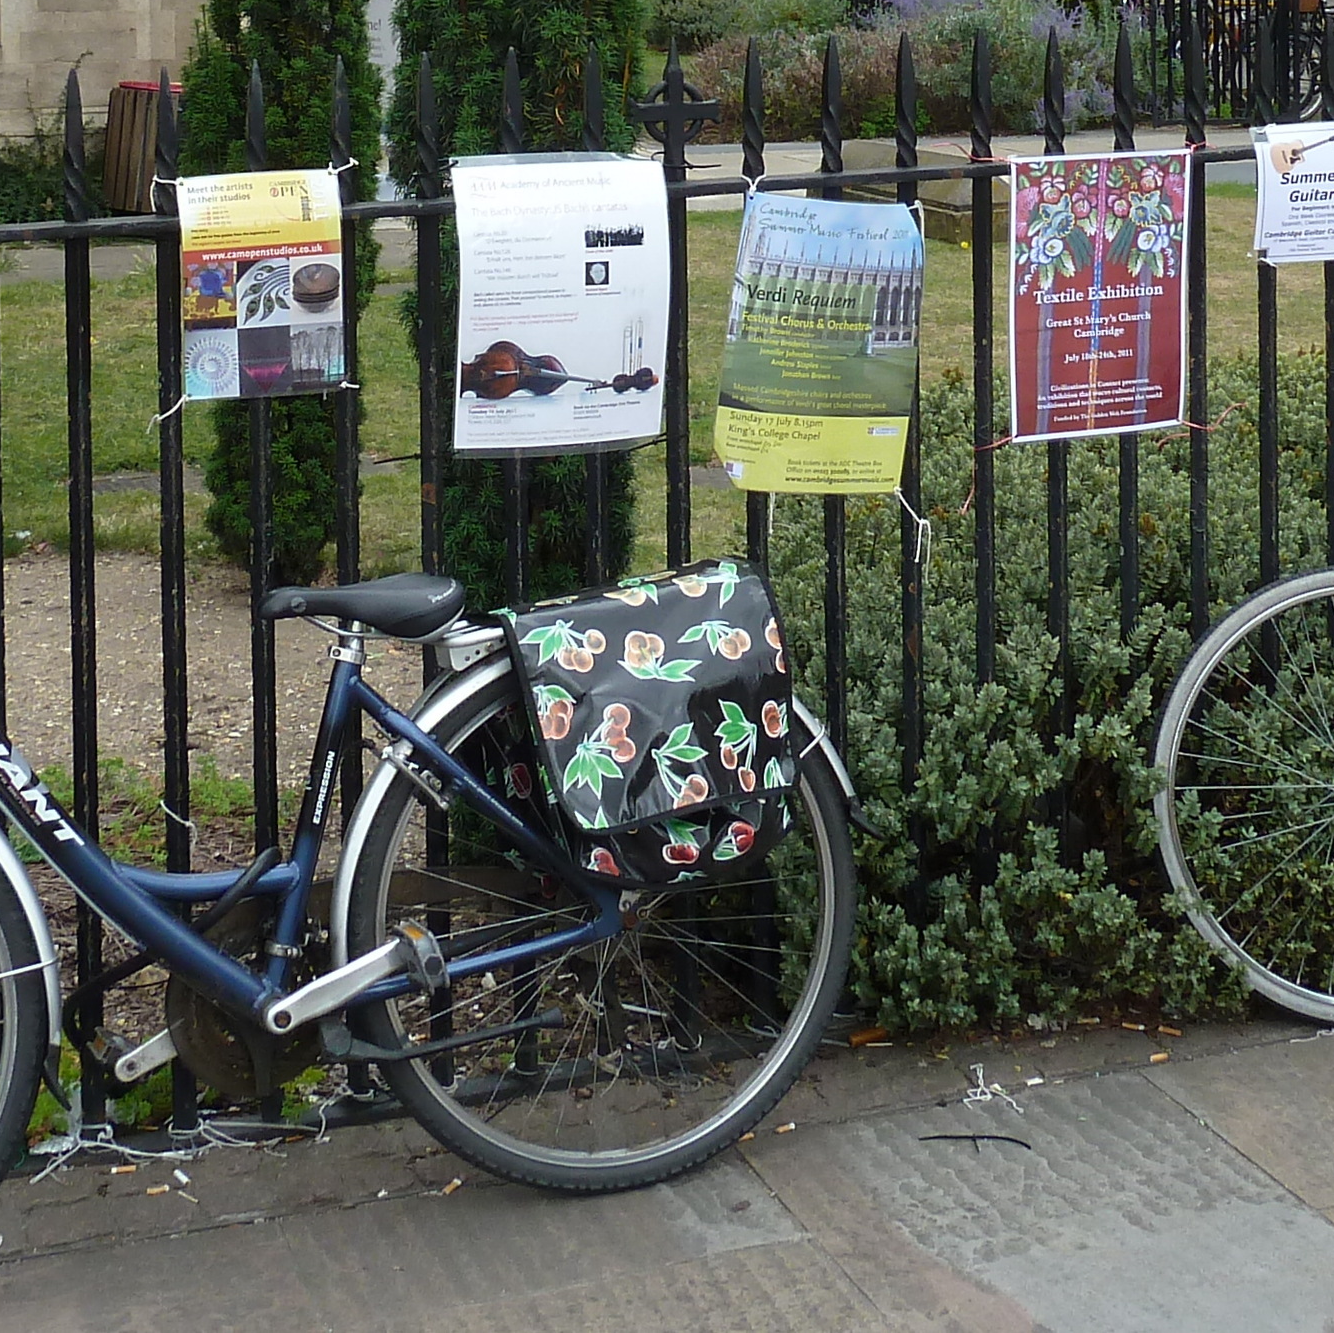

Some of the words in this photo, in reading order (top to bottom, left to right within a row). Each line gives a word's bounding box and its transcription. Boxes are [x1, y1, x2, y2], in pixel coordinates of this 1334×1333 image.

[187, 185, 209, 195] Meet
[211, 183, 225, 193] the
[225, 181, 253, 192] artists
[500, 179, 539, 190] Academy
[198, 194, 218, 204] their
[219, 192, 251, 203] studios
[760, 202, 817, 224] Cambridge
[759, 218, 806, 234] Summer
[847, 227, 889, 241] Festival
[202, 242, 323, 262] www.camopenstudios.co.uk
[747, 284, 787, 304] Verdi
[792, 289, 857, 312] Requiem
[1033, 287, 1084, 305] Textile
[1087, 282, 1163, 300] Exhibition
[742, 312, 777, 326] Festival
[781, 316, 814, 330] Chorus
[816, 319, 824, 329] &
[827, 320, 872, 331] Orchestra
[1046, 317, 1072, 328] Great
[1073, 316, 1083, 326] St
[1085, 313, 1117, 326] Mary's
[1118, 311, 1151, 322] Church
[1073, 326, 1125, 339] Cambridge
[1064, 354, 1080, 364] July
[1117, 349, 1134, 358] 2011
[729, 411, 762, 426] Sunday
[776, 416, 791, 428] July
[728, 423, 755, 438] King's
[758, 429, 789, 441] College
[791, 430, 821, 442] Chapel
[312, 749, 336, 825] EXPRESSION
